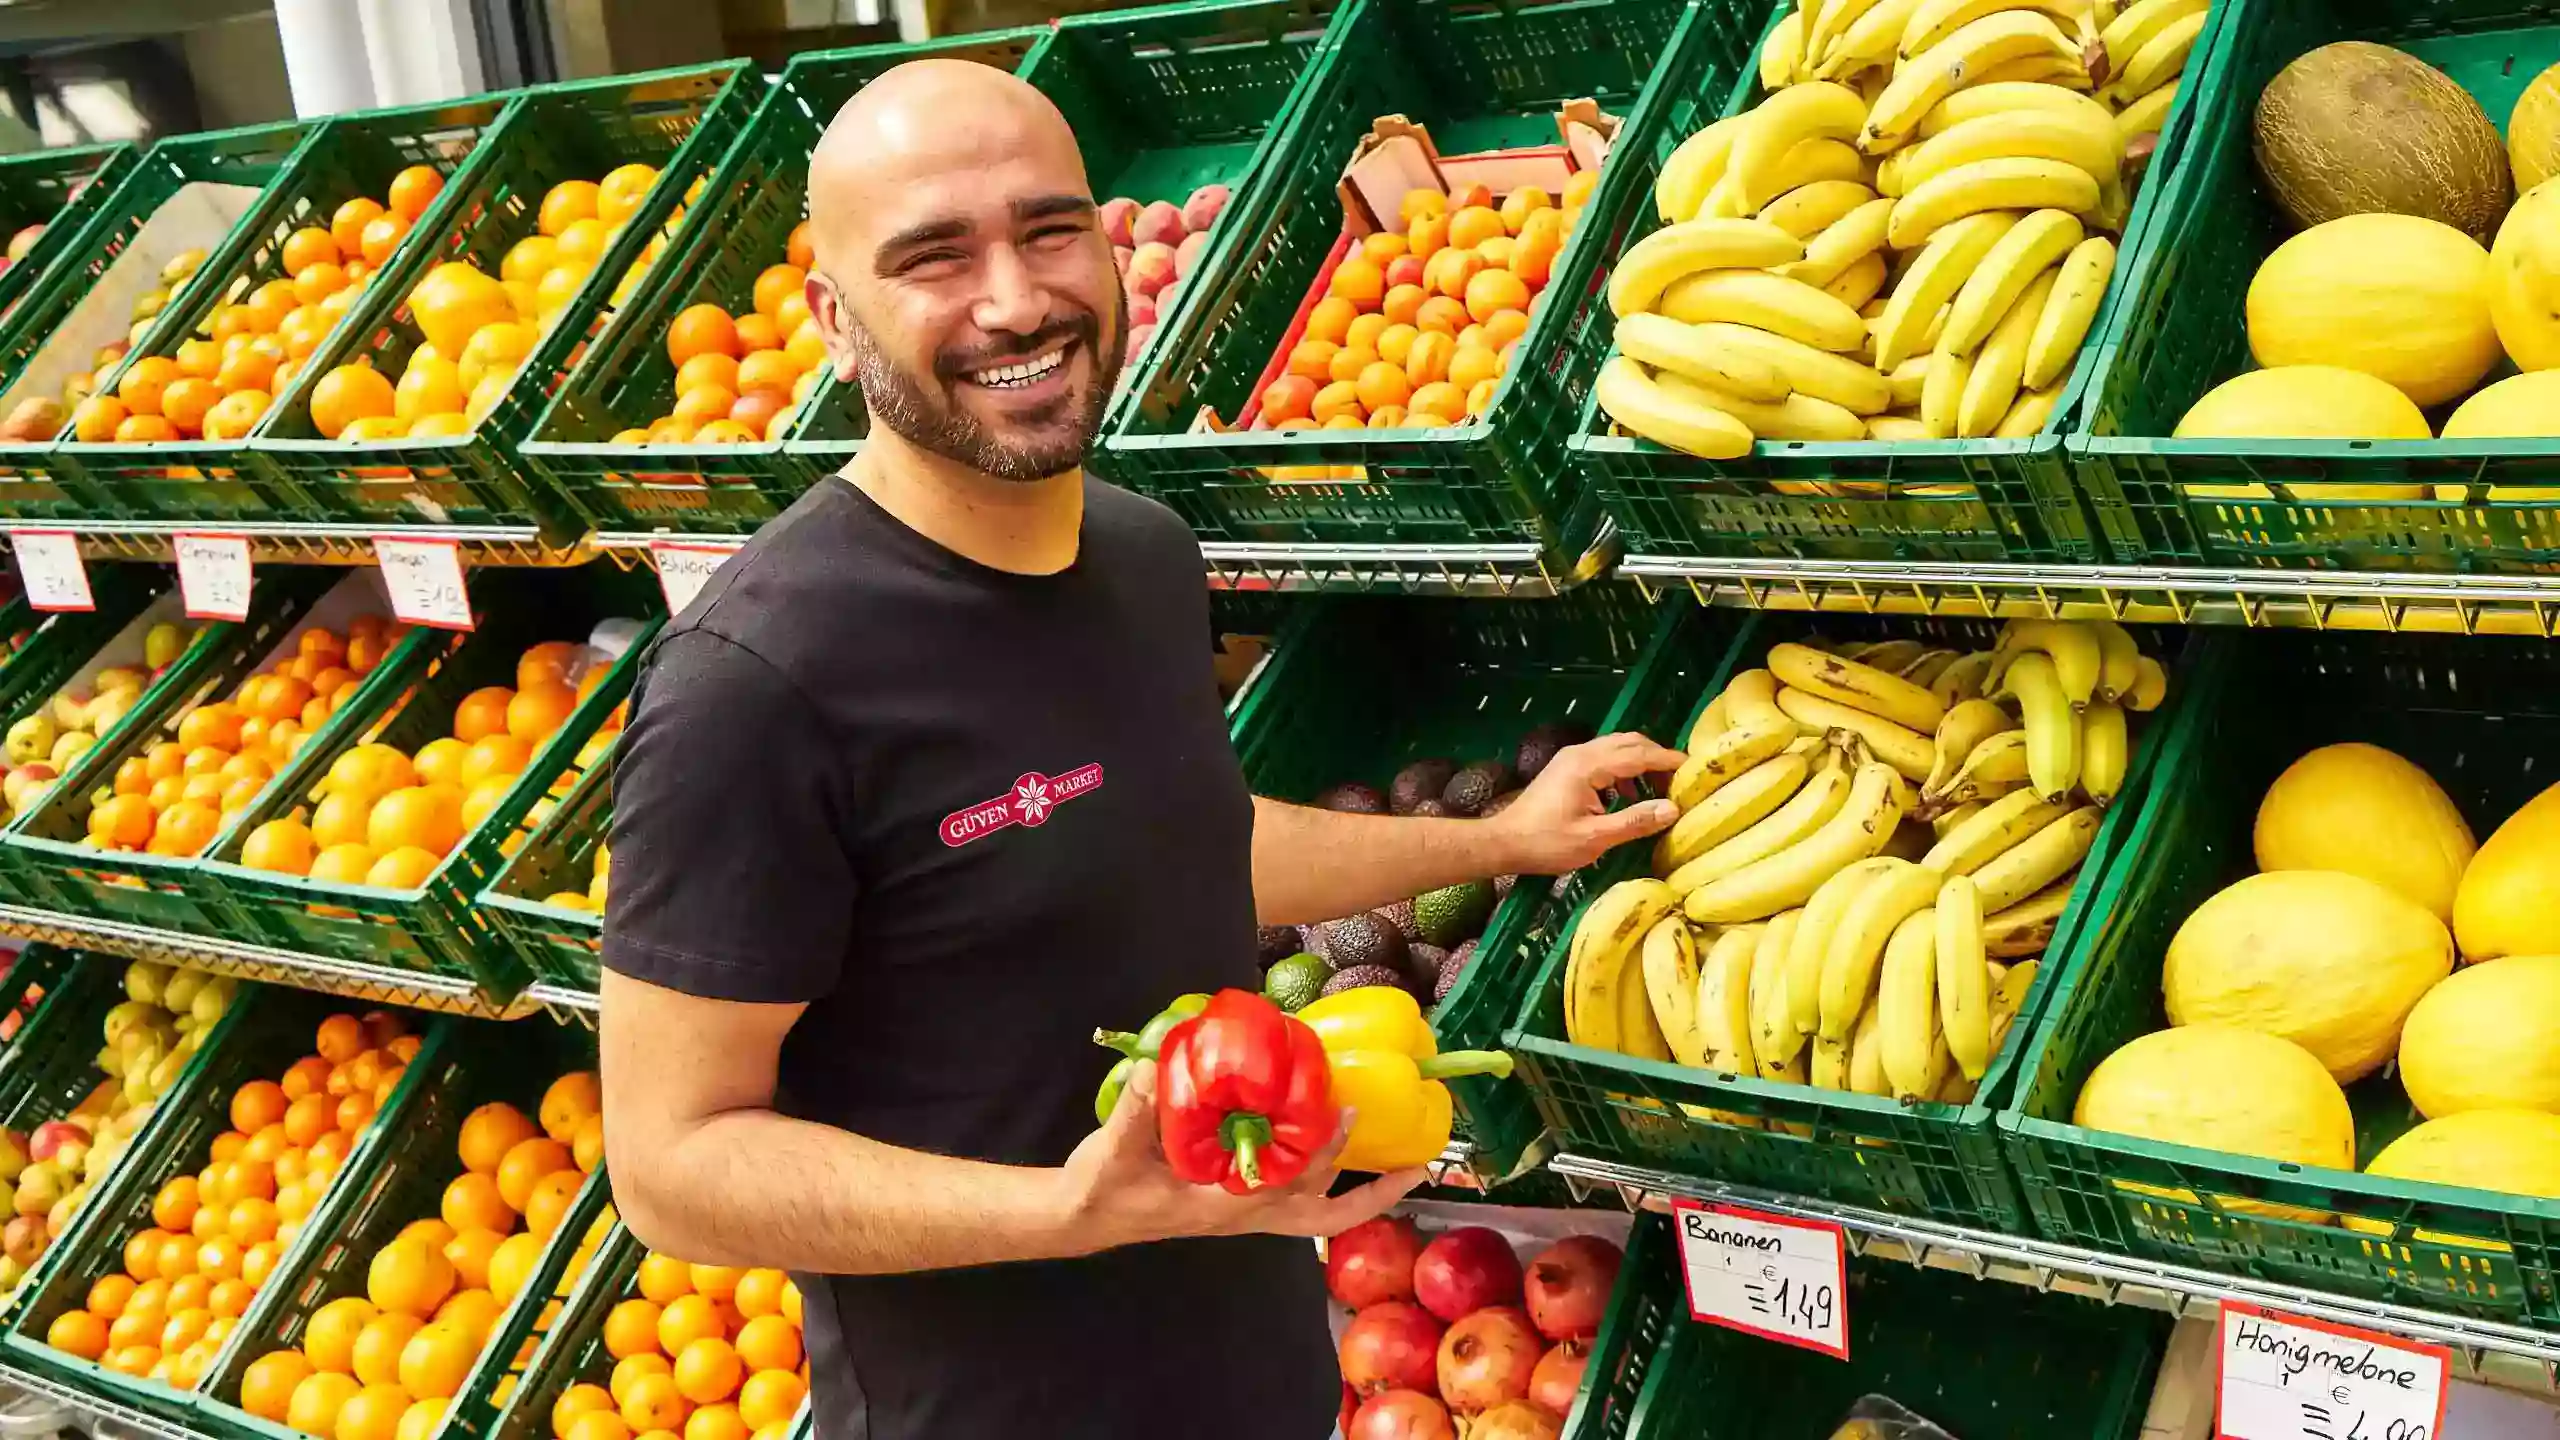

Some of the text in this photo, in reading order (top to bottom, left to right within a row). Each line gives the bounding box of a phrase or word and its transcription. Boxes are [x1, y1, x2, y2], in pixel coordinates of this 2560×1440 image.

[950, 768, 1099, 838] GÜVEN MARKET
[1685, 1214, 1782, 1253] Bananen
[1773, 1277, 1832, 1330] 1,49
[2235, 1320, 2416, 1390] Honigmelone
